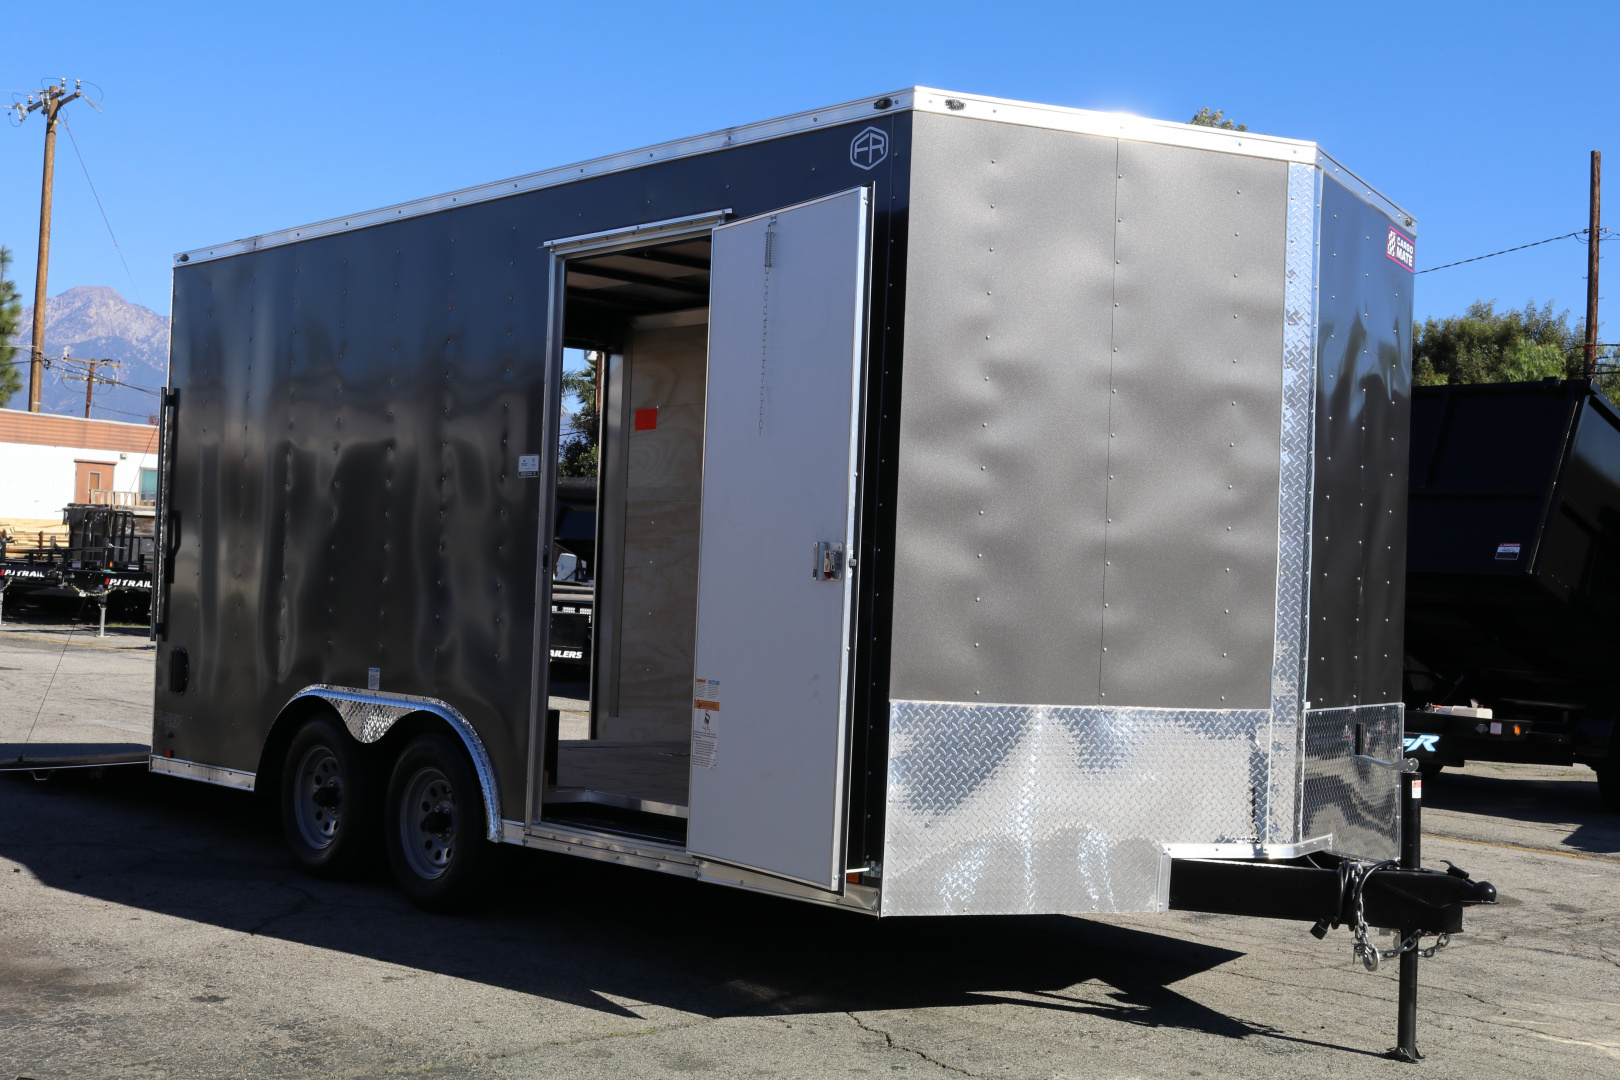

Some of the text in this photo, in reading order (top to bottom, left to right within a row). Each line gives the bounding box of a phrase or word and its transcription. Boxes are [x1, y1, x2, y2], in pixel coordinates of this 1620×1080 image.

[1397, 237, 1413, 254] CARGO
[1396, 246, 1413, 267] MATE
[108, 578, 121, 586] PJ
